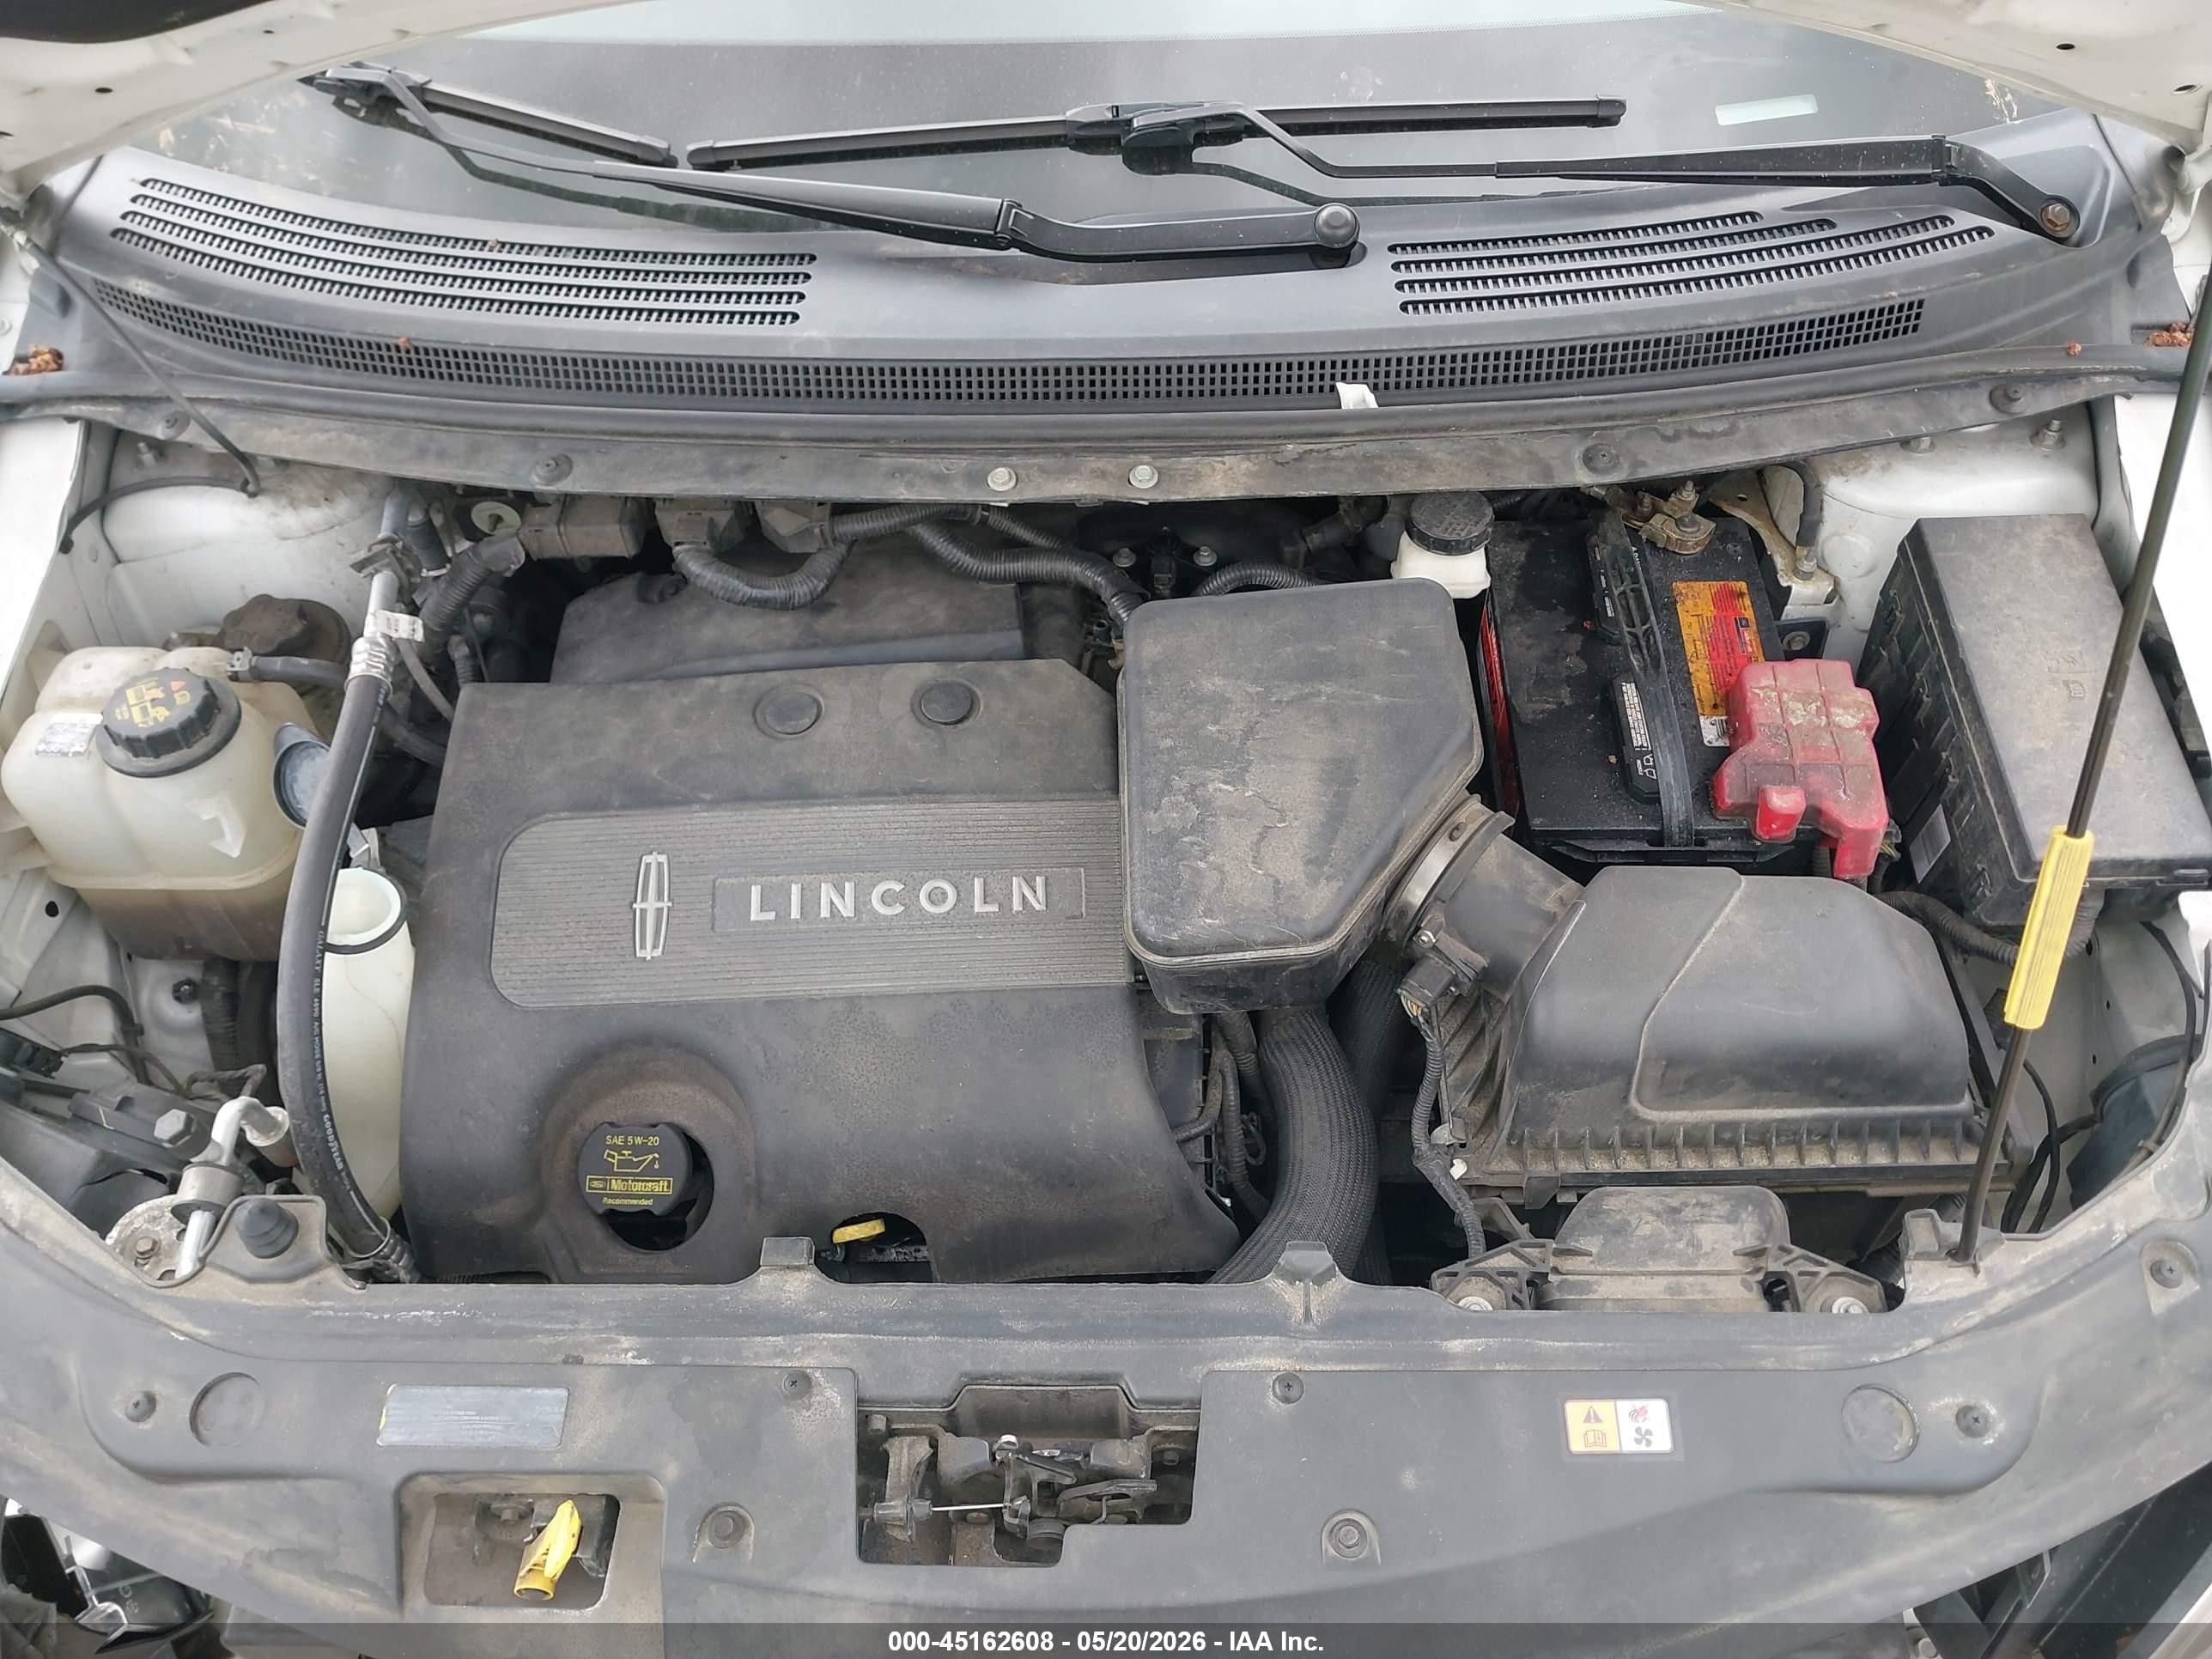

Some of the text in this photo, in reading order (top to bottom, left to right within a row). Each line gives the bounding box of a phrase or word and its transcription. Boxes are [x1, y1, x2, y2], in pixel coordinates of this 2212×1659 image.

[750, 876, 1048, 921] LINCOLN
[313, 1036, 322, 1060] HOSE
[323, 1114, 343, 1170] GOODYEAR
[605, 1135, 660, 1146] SAE 5W-20
[611, 1178, 669, 1193] Motorcraft
[602, 1196, 653, 1206] Recommended
